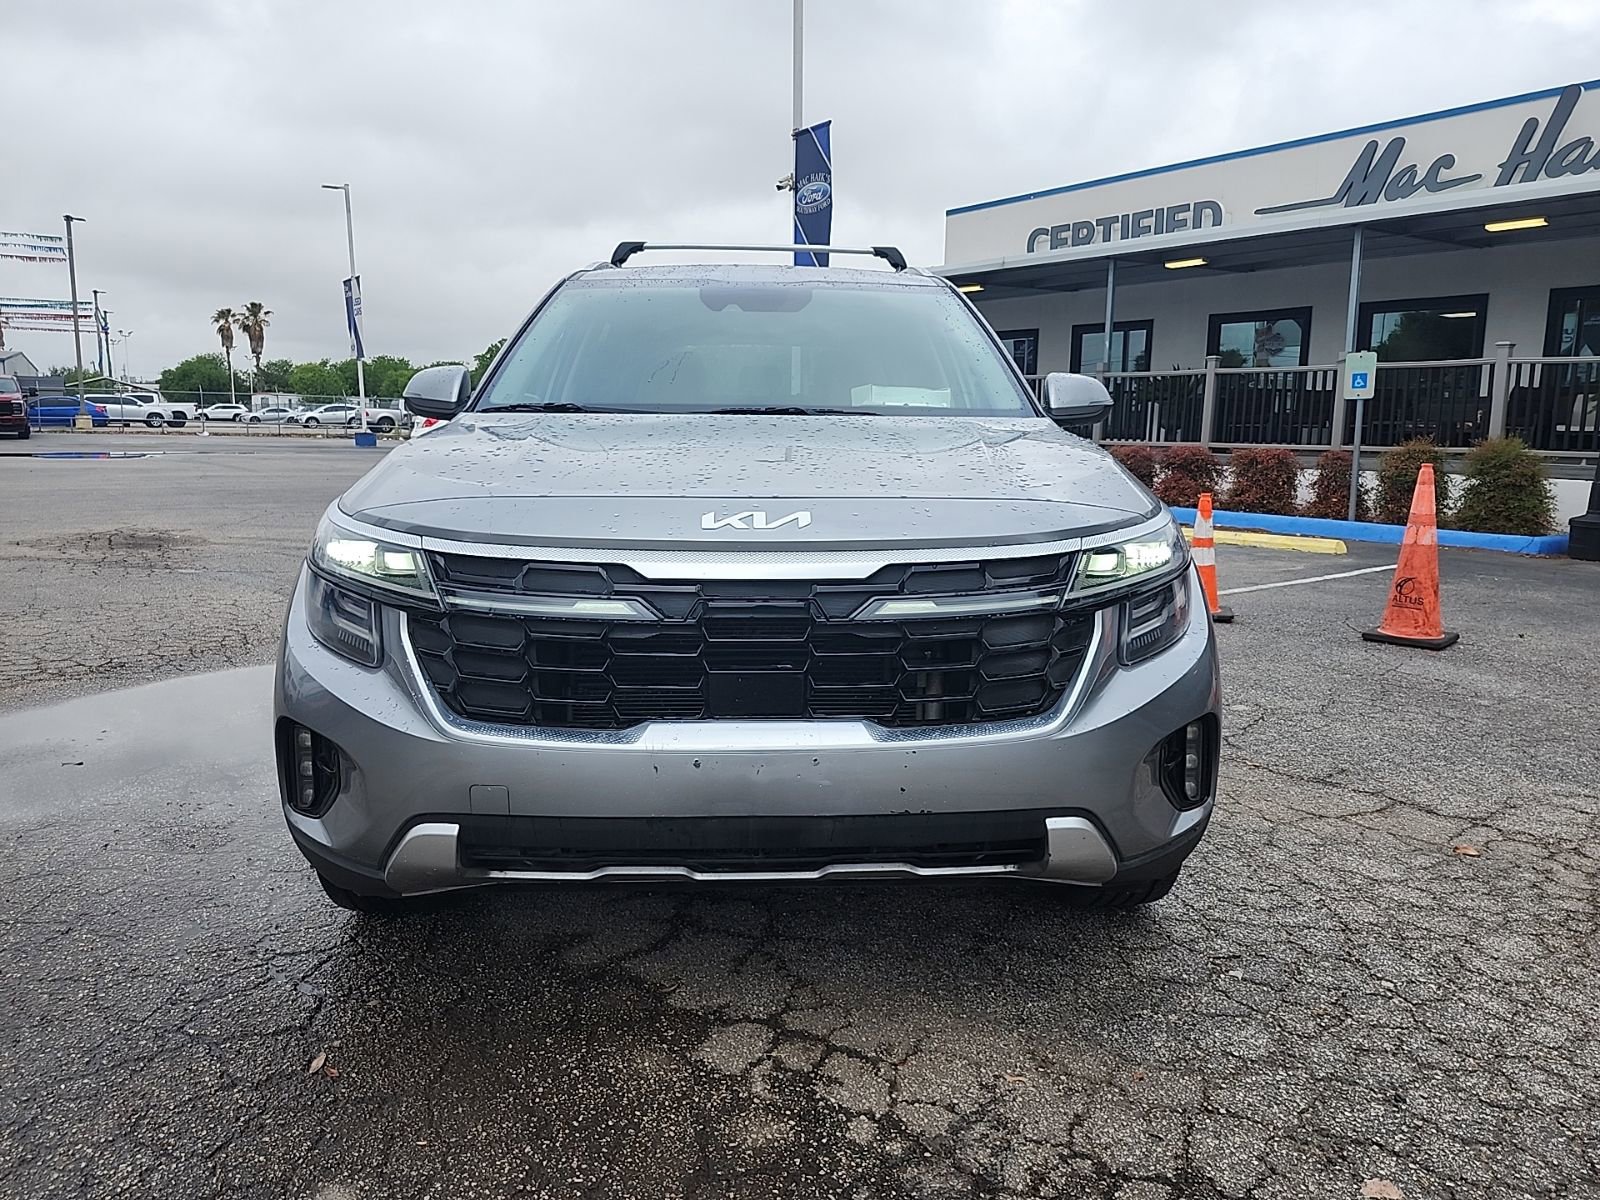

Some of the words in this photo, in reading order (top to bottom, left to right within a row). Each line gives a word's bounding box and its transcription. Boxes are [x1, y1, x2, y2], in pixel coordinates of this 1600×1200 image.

[1253, 136, 1482, 215] Mac
[1493, 84, 1600, 187] Ha
[797, 175, 809, 189] MAC
[801, 185, 823, 203] Ford
[1026, 199, 1223, 254] CERTIFIED
[701, 511, 811, 530] KIA
[1392, 594, 1424, 606] ALTUS
